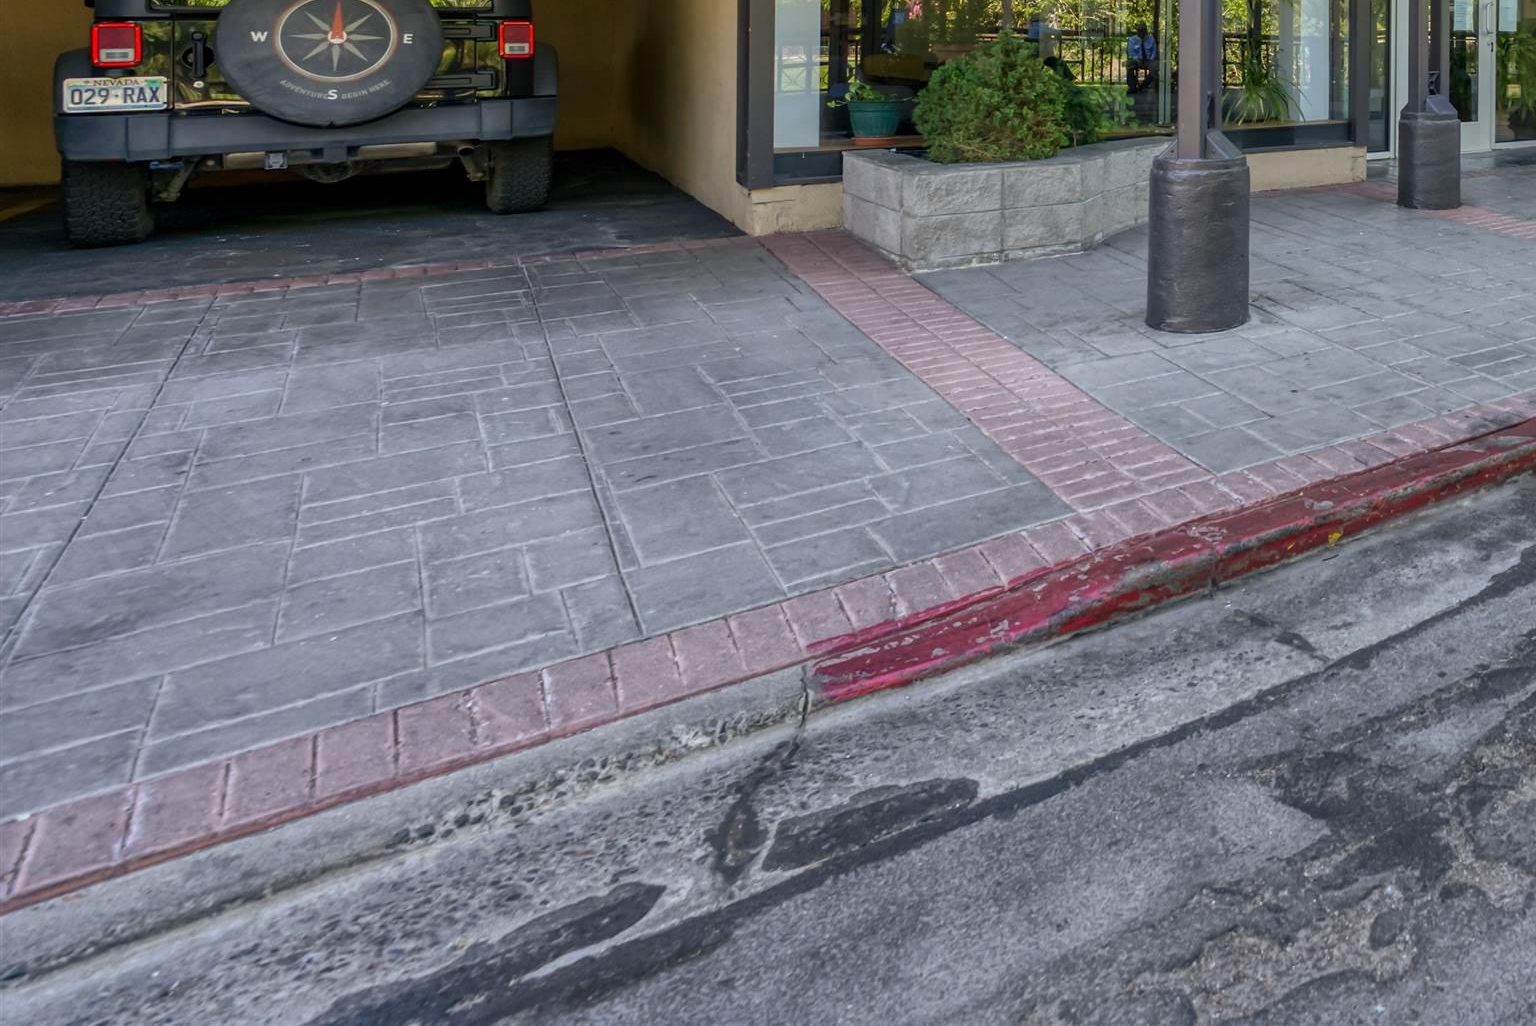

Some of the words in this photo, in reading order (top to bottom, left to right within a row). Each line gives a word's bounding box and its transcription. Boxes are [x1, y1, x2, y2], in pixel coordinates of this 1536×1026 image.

[250, 31, 268, 42] W
[402, 33, 413, 44] E
[93, 79, 140, 87] NEVADA
